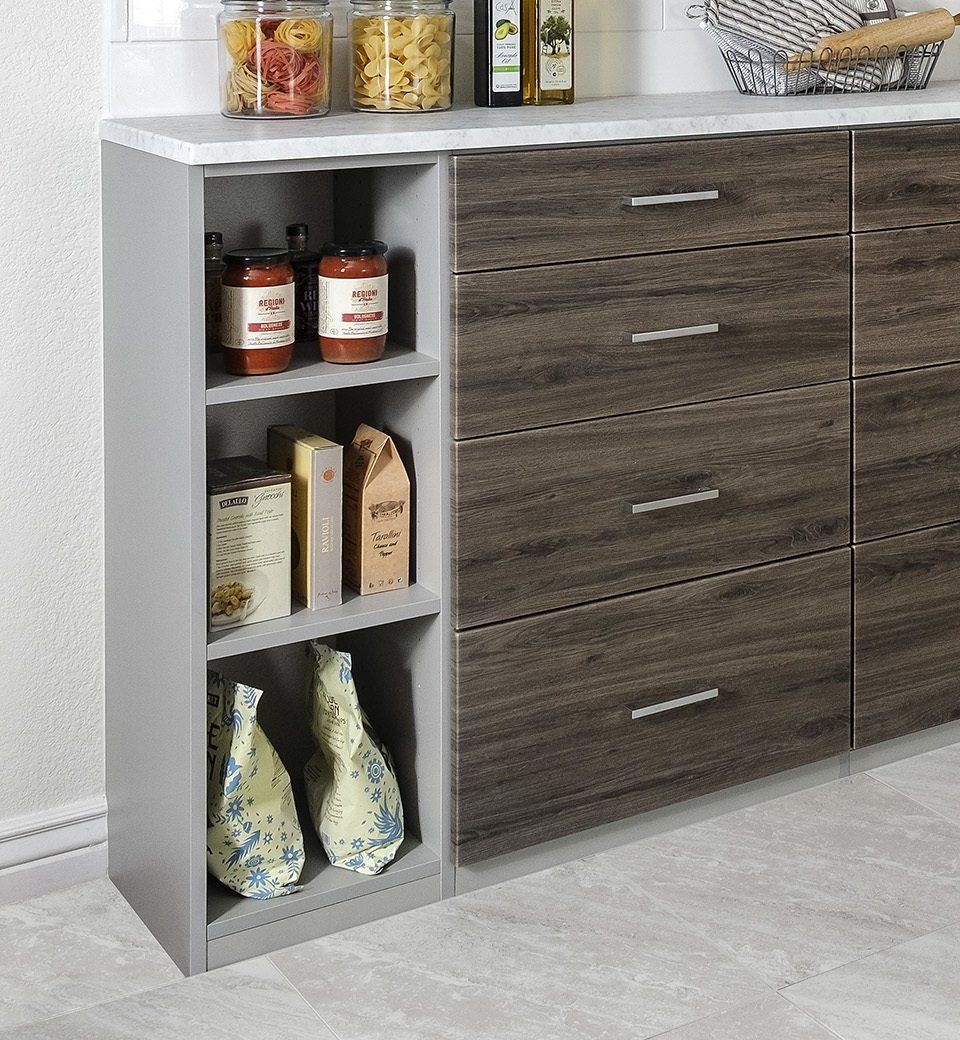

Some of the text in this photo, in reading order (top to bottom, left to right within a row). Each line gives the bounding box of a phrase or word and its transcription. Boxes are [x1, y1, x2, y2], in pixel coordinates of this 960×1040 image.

[351, 289, 378, 298] REGIONI
[258, 297, 285, 307] REGIONI
[321, 516, 330, 553] RAVIOLI
